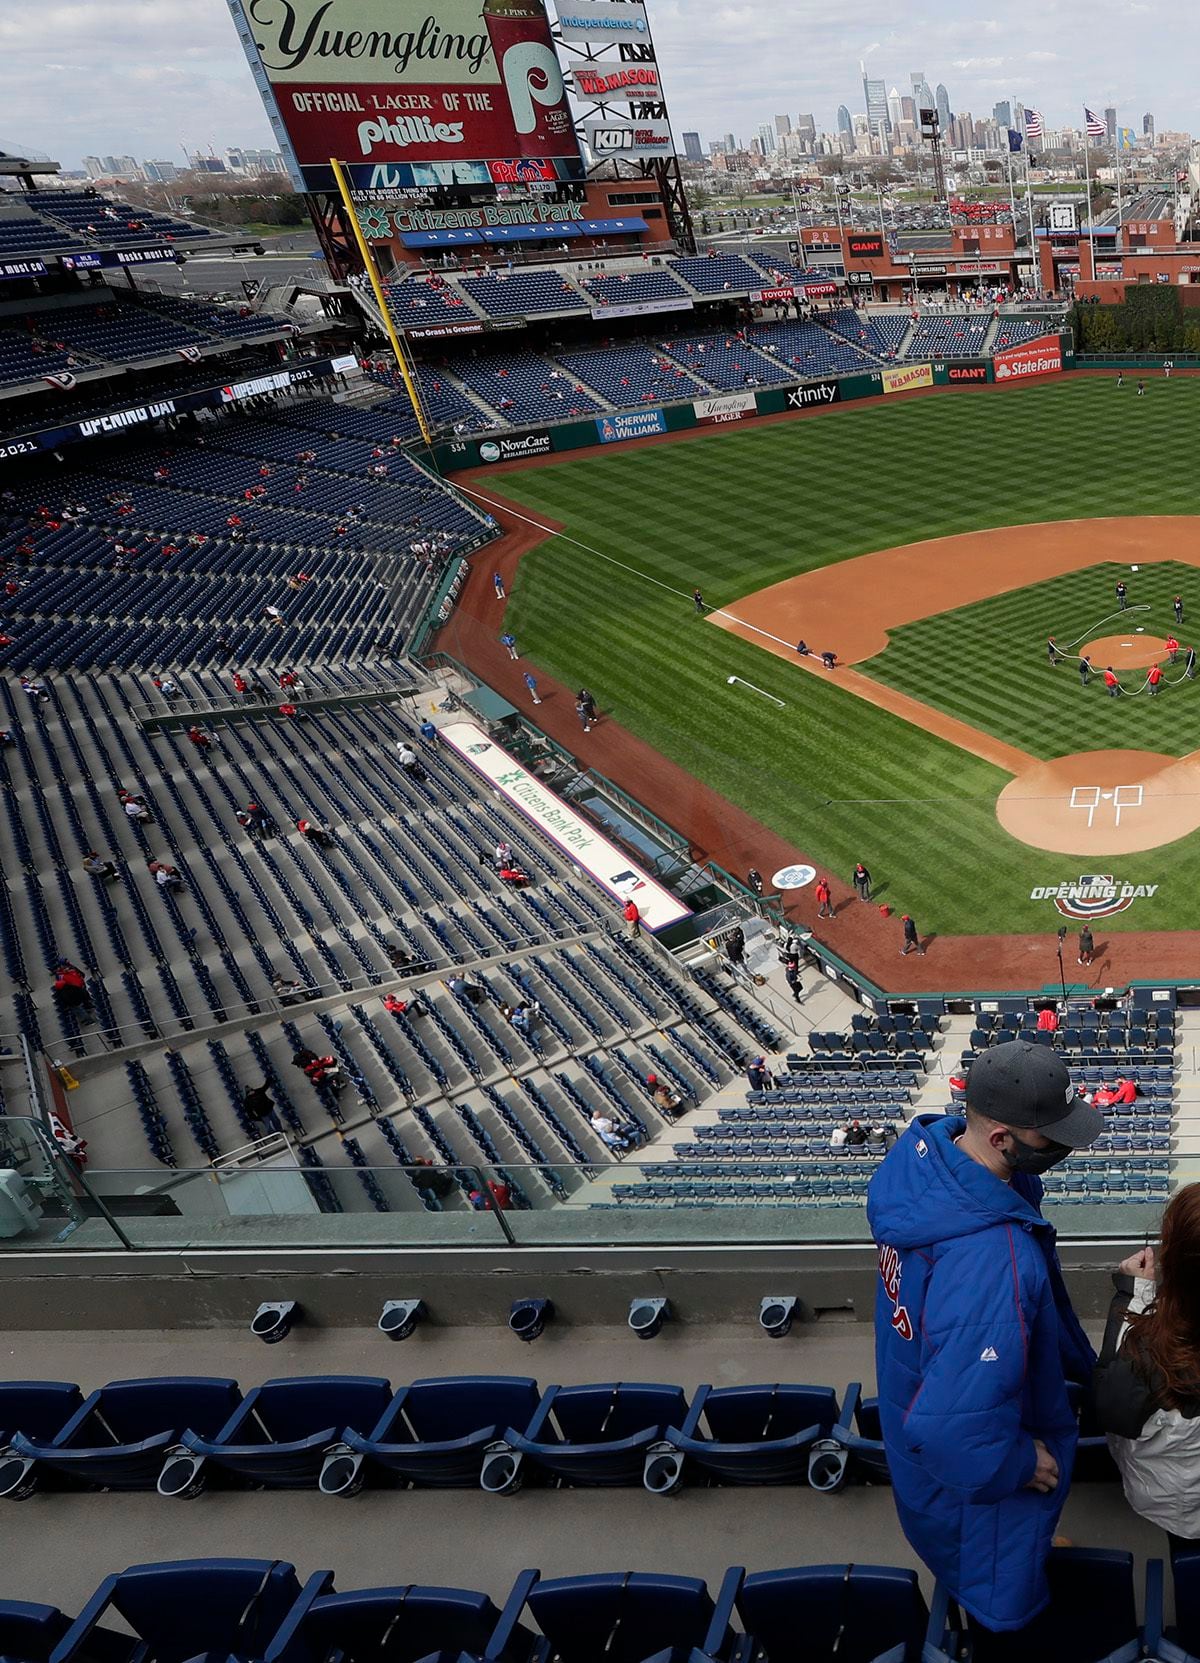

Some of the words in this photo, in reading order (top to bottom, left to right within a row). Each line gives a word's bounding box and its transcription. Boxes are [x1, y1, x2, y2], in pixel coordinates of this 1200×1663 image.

[560, 15, 634, 30] Independence
[250, 0, 492, 74] Yuengling
[292, 92, 365, 112] OFFICIAL
[370, 94, 433, 110] LAGER
[442, 93, 460, 111] OF
[463, 93, 493, 111] THE
[431, 162, 472, 184] VS
[393, 206, 483, 232] Citizens
[483, 201, 539, 226] Bank
[538, 200, 584, 222] Park
[852, 243, 880, 252] GIANT
[763, 289, 792, 299] TOYOTA
[806, 285, 835, 295] TOYOTA
[410, 330, 424, 338] The
[425, 328, 445, 337] Grass
[949, 368, 985, 378] GIANT
[1011, 358, 1060, 376] StateFarm
[290, 370, 313, 382] 2021
[788, 383, 836, 407] xfinity
[702, 398, 749, 416] Yuengling
[614, 412, 658, 427] SHERWIN
[714, 411, 742, 423] LAGER
[0, 441, 37, 458] 2021
[450, 442, 466, 453] 334
[500, 435, 550, 452] NovaCare
[503, 446, 550, 459] REHABILITATION
[512, 781, 549, 818] Citizens
[543, 808, 572, 833] Bank
[565, 827, 595, 849] Park
[1030, 885, 1118, 900] OPENING
[1120, 884, 1159, 898] DAY
